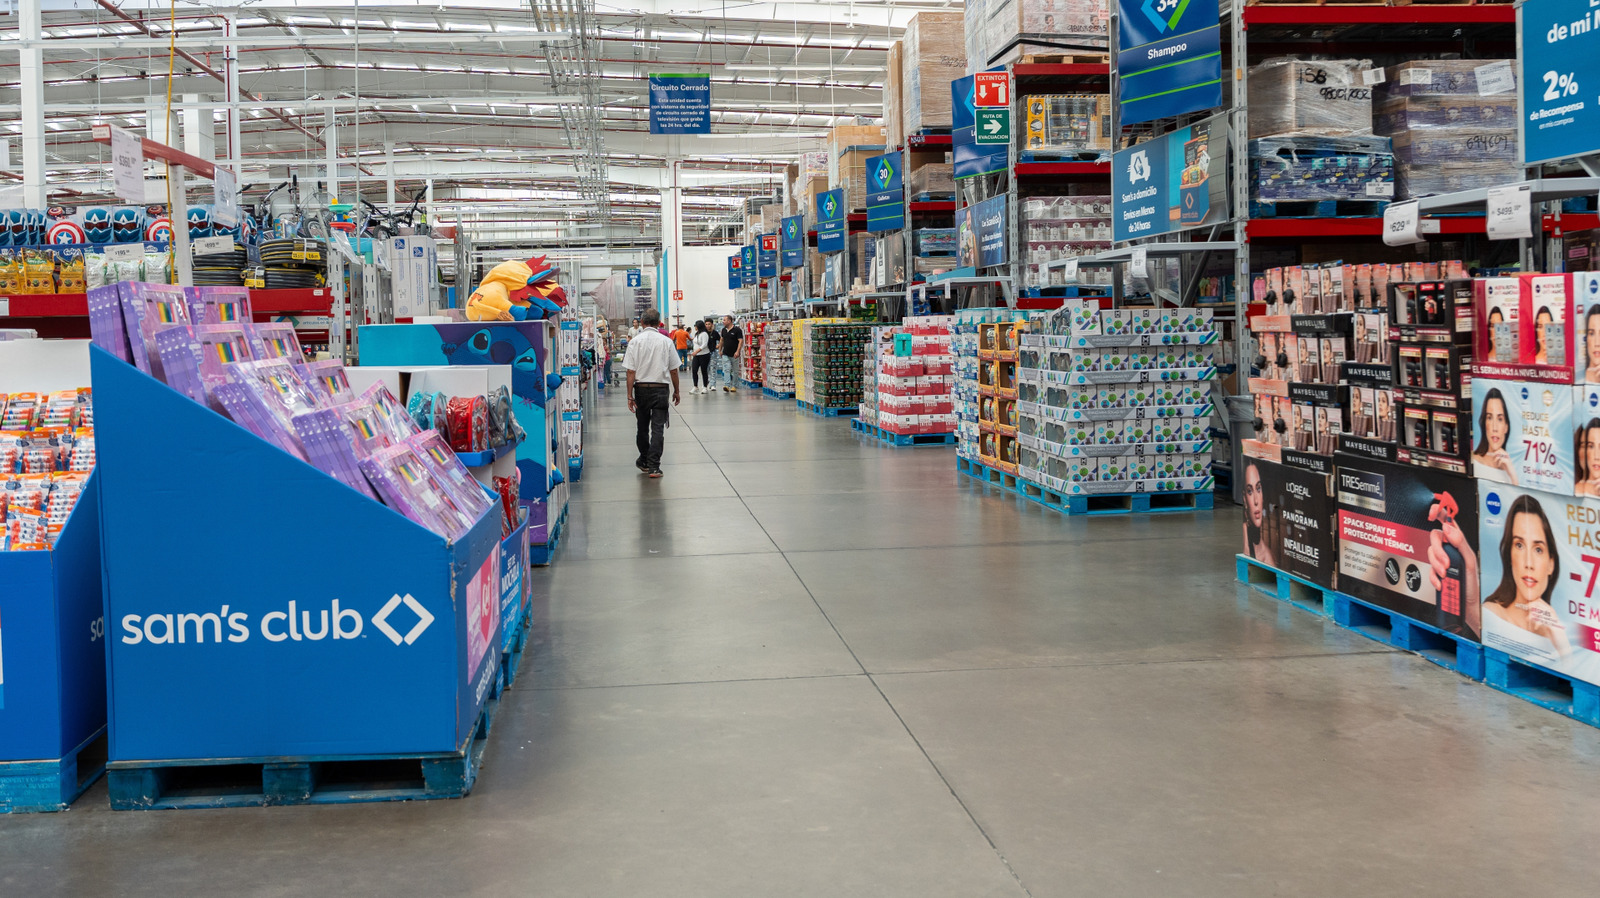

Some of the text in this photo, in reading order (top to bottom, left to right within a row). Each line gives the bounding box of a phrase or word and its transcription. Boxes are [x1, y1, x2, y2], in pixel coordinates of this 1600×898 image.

[1547, 23, 1568, 44] de
[1570, 12, 1591, 37] mi
[1147, 43, 1187, 60] Shampoo
[1543, 70, 1578, 102] 2%
[1530, 101, 1584, 121] de Recompensa
[879, 168, 888, 180] 30
[1136, 185, 1158, 198] domicilio
[1140, 206, 1156, 216] Menos
[1128, 220, 1152, 233] de 24 horas
[1348, 368, 1390, 378] MAYBELLINE
[1472, 365, 1480, 374] EL
[1480, 366, 1500, 374] SERUM
[1514, 368, 1519, 376] A
[1518, 368, 1538, 378] NIVEL
[1293, 388, 1328, 398] MAYBELLINE
[1522, 411, 1549, 422] REDUCE
[1522, 425, 1550, 438] HASTA
[1345, 441, 1387, 455] MAYBELLINE
[1523, 440, 1556, 466] 71%
[1286, 456, 1324, 468] MAYBELLINE
[1523, 466, 1531, 474] DE
[1341, 474, 1380, 494] TRESemmé
[1283, 510, 1318, 530] PANORAMA
[1566, 504, 1600, 525] RED
[1343, 516, 1396, 538] 2PACK SPRAY DE
[1284, 538, 1319, 559] INFAILLIBLE
[1344, 527, 1414, 554] PROTECCIÓN TÉRMICA
[1569, 600, 1586, 618] DE
[121, 598, 364, 646] sam's club
